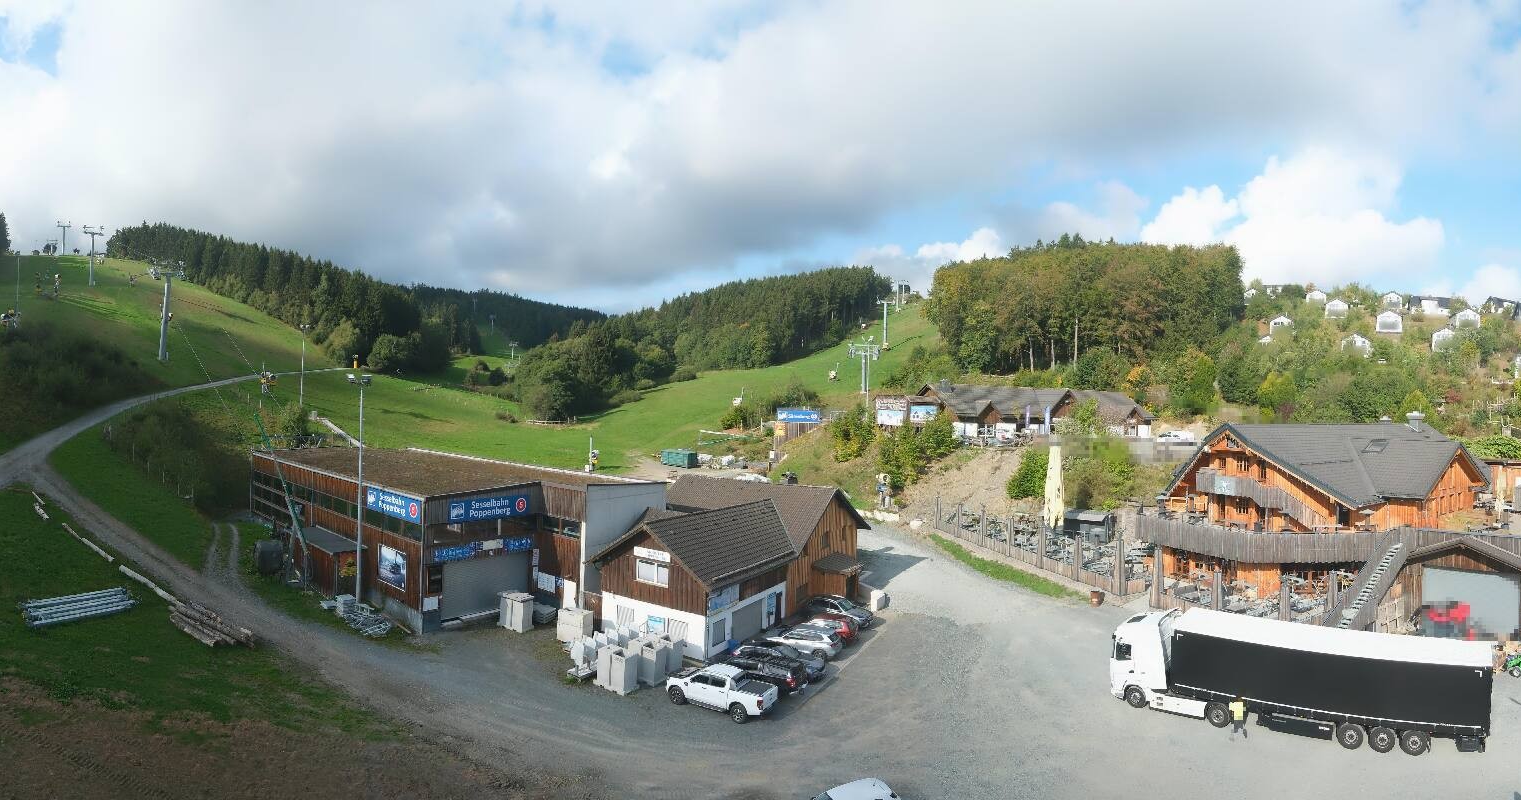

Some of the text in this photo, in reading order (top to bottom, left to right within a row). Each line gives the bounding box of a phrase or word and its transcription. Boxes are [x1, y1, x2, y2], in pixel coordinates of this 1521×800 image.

[379, 492, 405, 506] Sesselbahn
[471, 498, 509, 509] Sesselbahn
[379, 500, 406, 517] Poppenberg
[469, 507, 511, 519] Poppenberg
